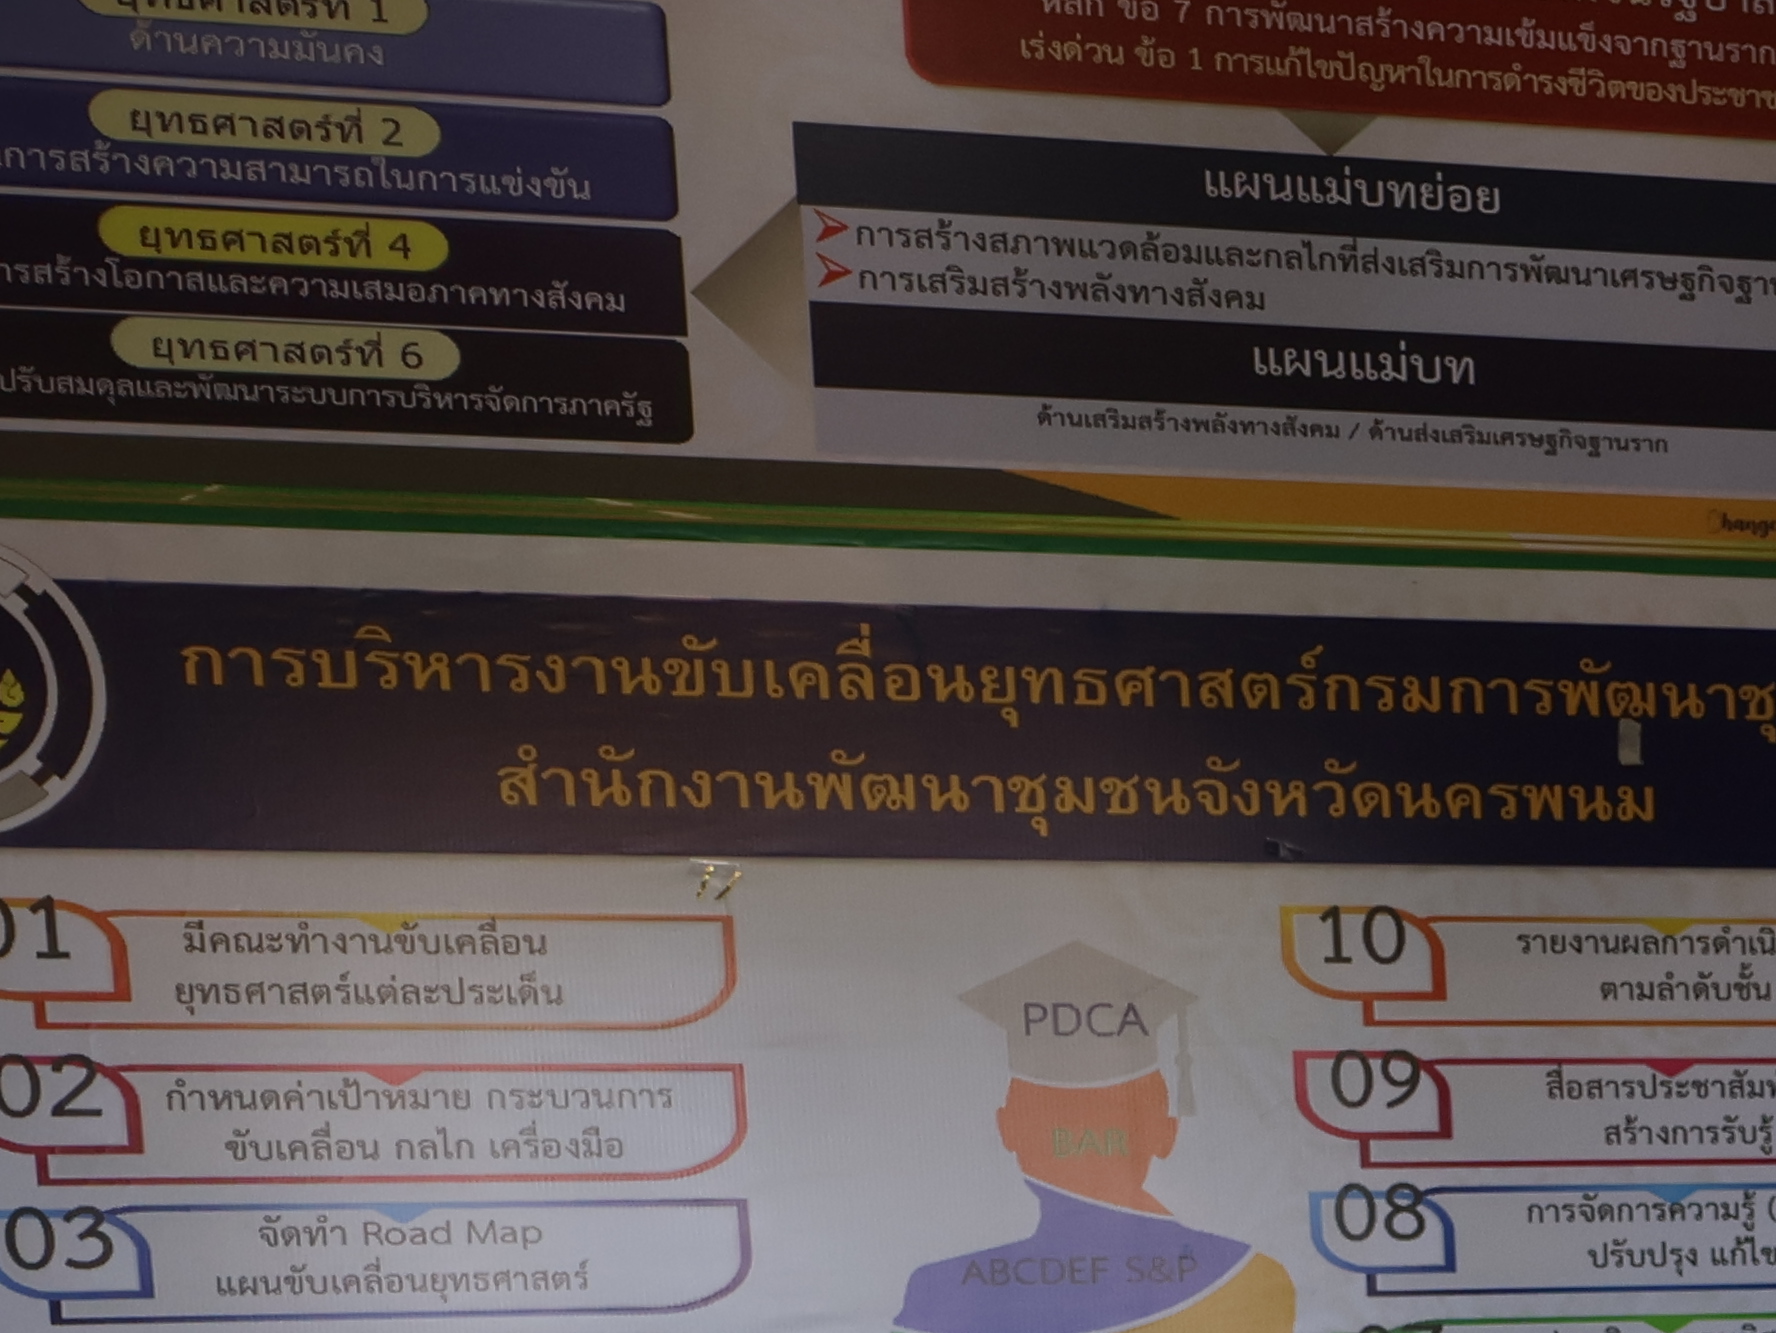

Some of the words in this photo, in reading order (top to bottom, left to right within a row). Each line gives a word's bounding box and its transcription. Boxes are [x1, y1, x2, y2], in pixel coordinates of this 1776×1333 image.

[1173, 1, 1194, 24] 7
[1018, 32, 1126, 69] เร่งด่วน
[1135, 39, 1177, 70] ข้อ
[1189, 47, 1203, 71] 1
[130, 105, 364, 149] ยุทธศาสตร์ที่
[381, 118, 403, 147] 2
[0, 139, 591, 203] การสร้างความสามารถในการแข่งขัน
[1204, 160, 1502, 218] แผนแม่บทย่อย
[139, 220, 373, 262] ยุทธศาสตร์ที่
[388, 232, 412, 262] 4
[0, 257, 626, 315] ารสร้างโอกาสและความเสมอภาคทางสังคม
[858, 258, 1267, 314] การเสริมสร้างพลังทางสังคม
[152, 331, 384, 372] ยุทธศาสตร์ที่
[400, 340, 424, 370] 6
[1253, 338, 1477, 390] แผนแม่บท
[1036, 402, 1341, 441] ด้านเสริมสร้างพลังทางสังคม
[497, 743, 1657, 837] สำนักงานพัฒนาชุมชนจังหวัดนครพนม
[183, 915, 549, 958] มีคณะทำงานขับเคลื่อน
[1318, 904, 1406, 966] 10
[174, 972, 565, 1021] ยุทธศาสตร์แต่ละประเด็น
[1599, 963, 1772, 1004] ตามลำดับชั้น
[1022, 1001, 1150, 1038] PDCA
[0, 1053, 103, 1118] 02
[166, 1072, 471, 1113] กำหนดค่าเป้าหมาย
[486, 1083, 674, 1112] กระบวนการ
[1331, 1049, 1422, 1109] 09
[225, 1121, 380, 1164] ขับเคลื่อน
[394, 1131, 476, 1162] กลไก
[489, 1120, 625, 1162] เครื่องมือ
[1053, 1127, 1130, 1158] BAR
[1603, 1113, 1775, 1156] สร้างการรับรู้
[1334, 1182, 1428, 1241] 08
[1525, 1189, 1757, 1233] การจัดการความรู้
[5, 1204, 116, 1272] 03
[258, 1216, 346, 1249] จัดทำ
[363, 1219, 451, 1248] Road
[467, 1219, 542, 1251] Map
[1588, 1239, 1700, 1271] ปรับปรุง
[215, 1259, 591, 1303] แผนขับเคลื่อนยุทธศาสตร์
[960, 1257, 1110, 1288] ABCDEF
[1124, 1254, 1200, 1285] S&P
